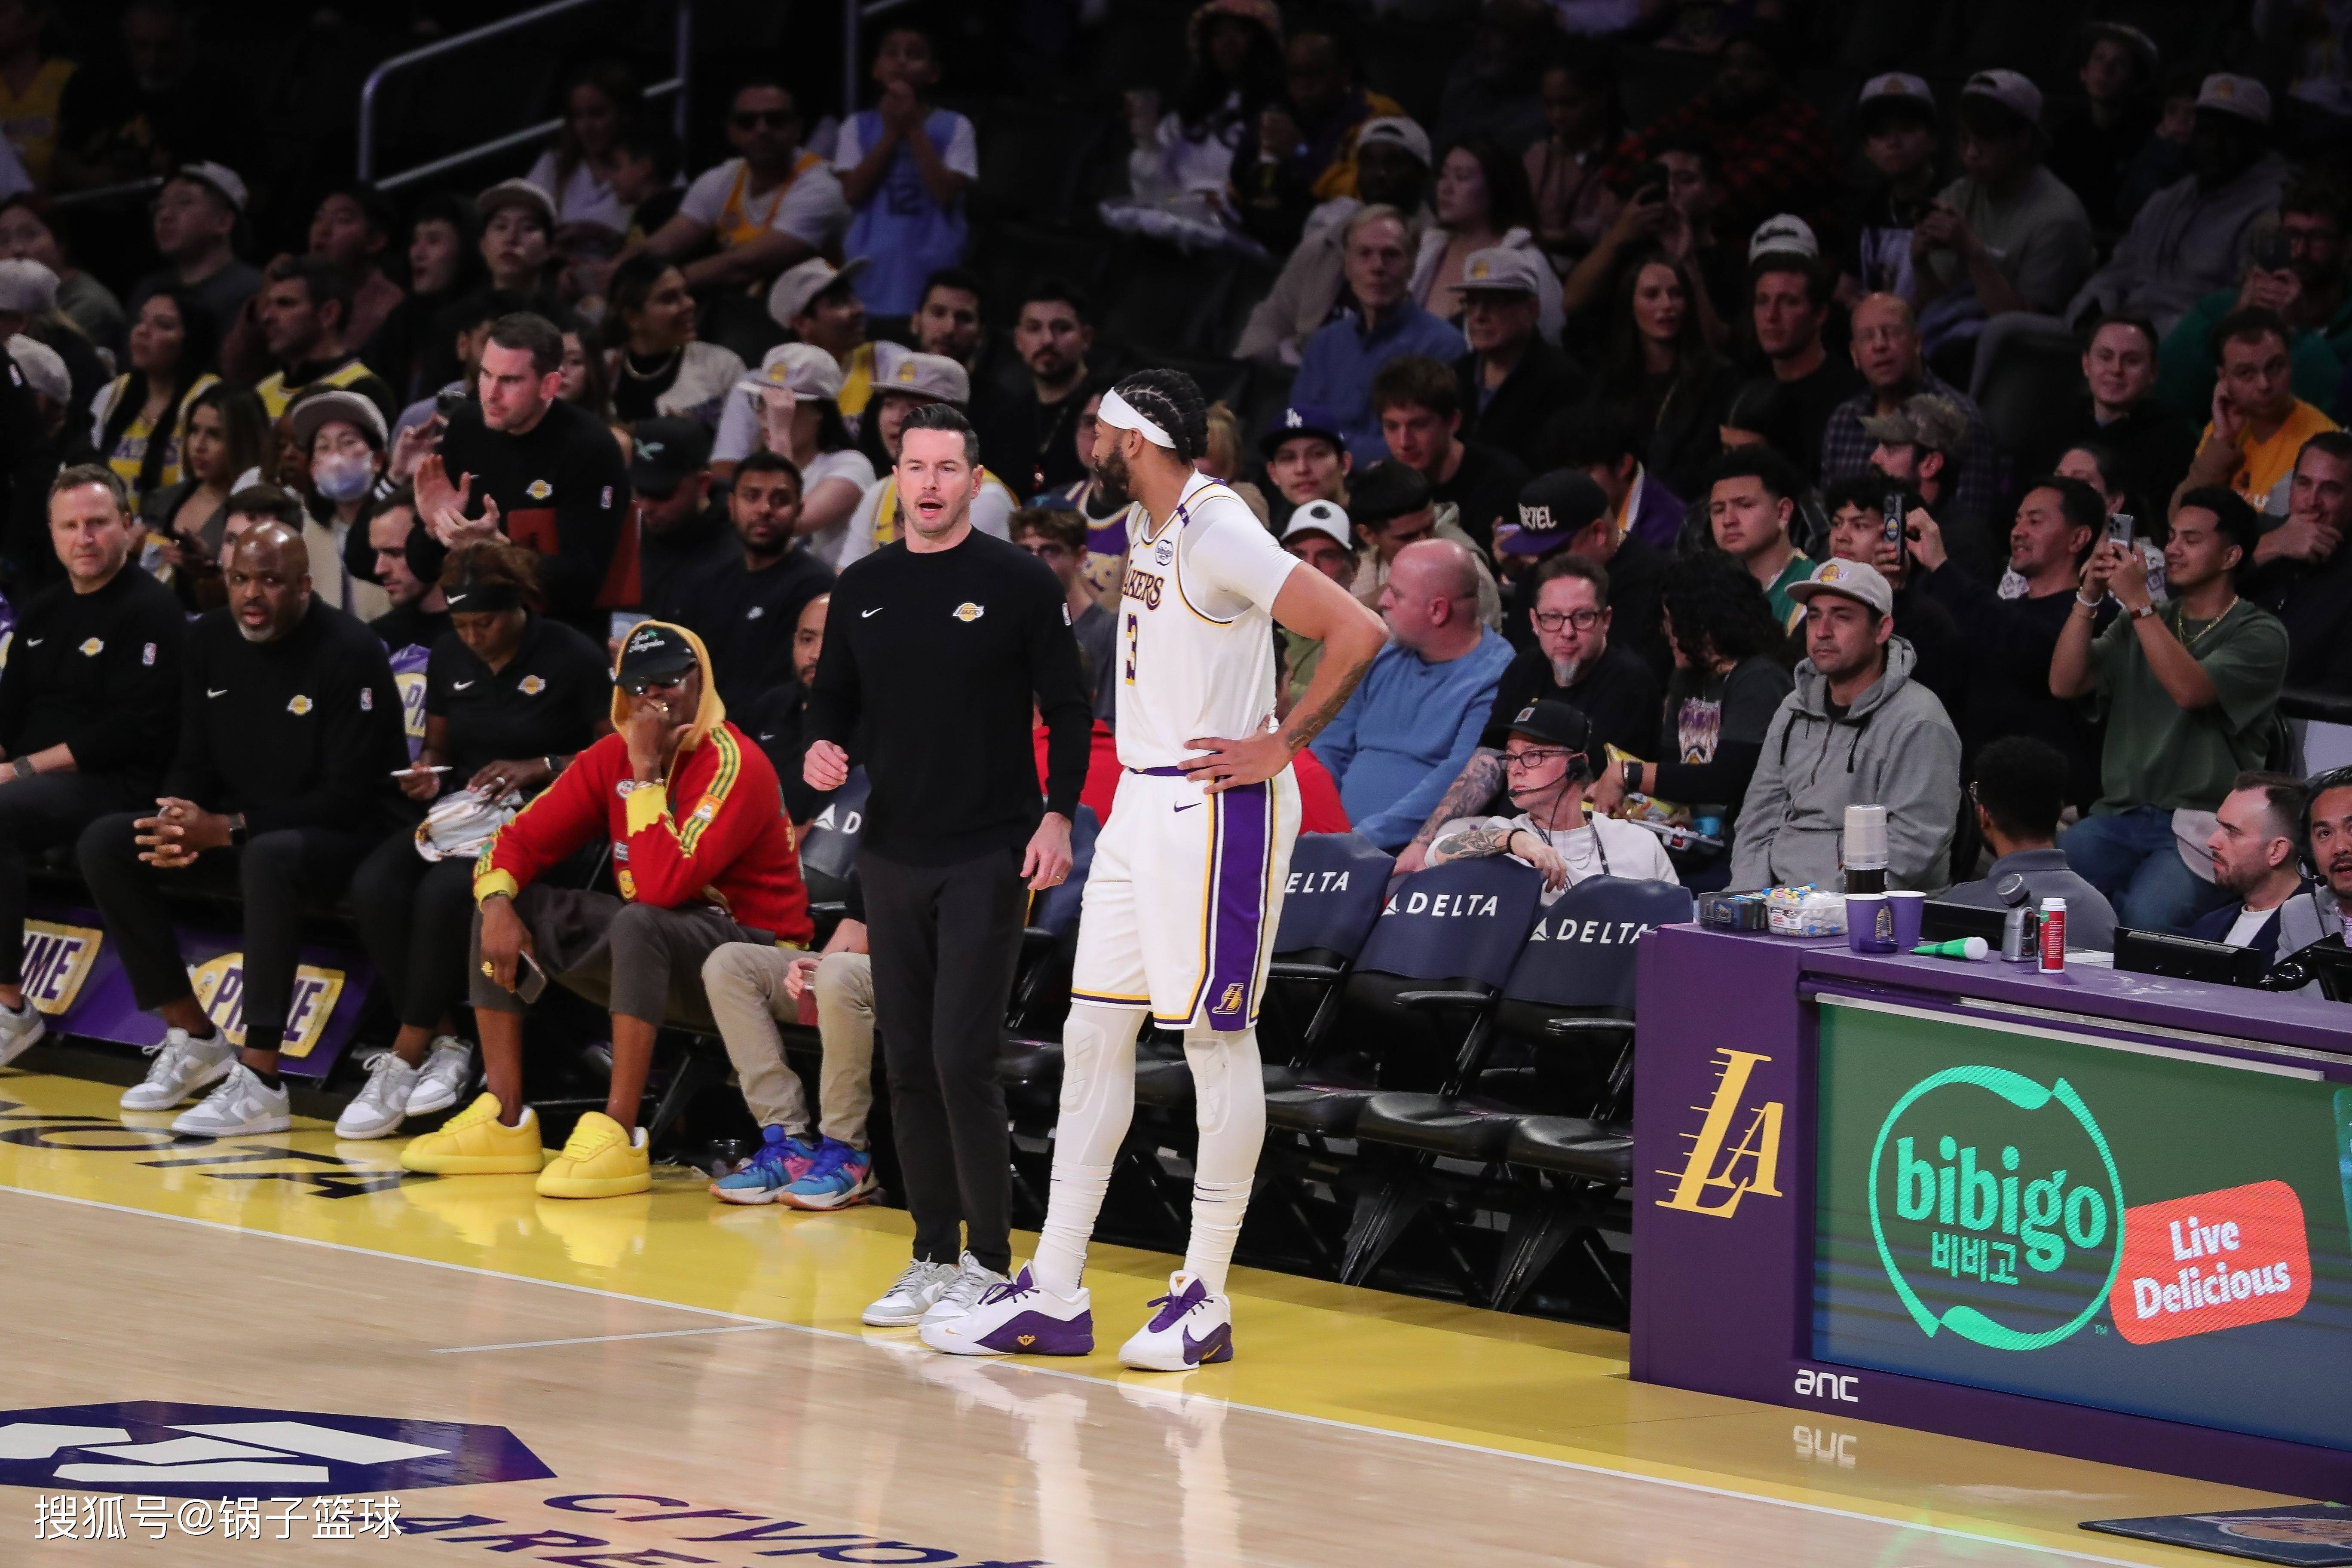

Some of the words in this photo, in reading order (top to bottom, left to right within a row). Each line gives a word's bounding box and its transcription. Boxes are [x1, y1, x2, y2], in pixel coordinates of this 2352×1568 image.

[1284, 871, 1350, 894] ELTA
[1406, 892, 1498, 917] DELTA
[1655, 1047, 1784, 1219] LA
[1897, 1135, 2107, 1272] bibigo
[1931, 1231, 2019, 1286] 비비고
[2169, 1216, 2240, 1262] Live
[2132, 1260, 2291, 1320] Delicious
[1795, 1369, 1859, 1403] anc
